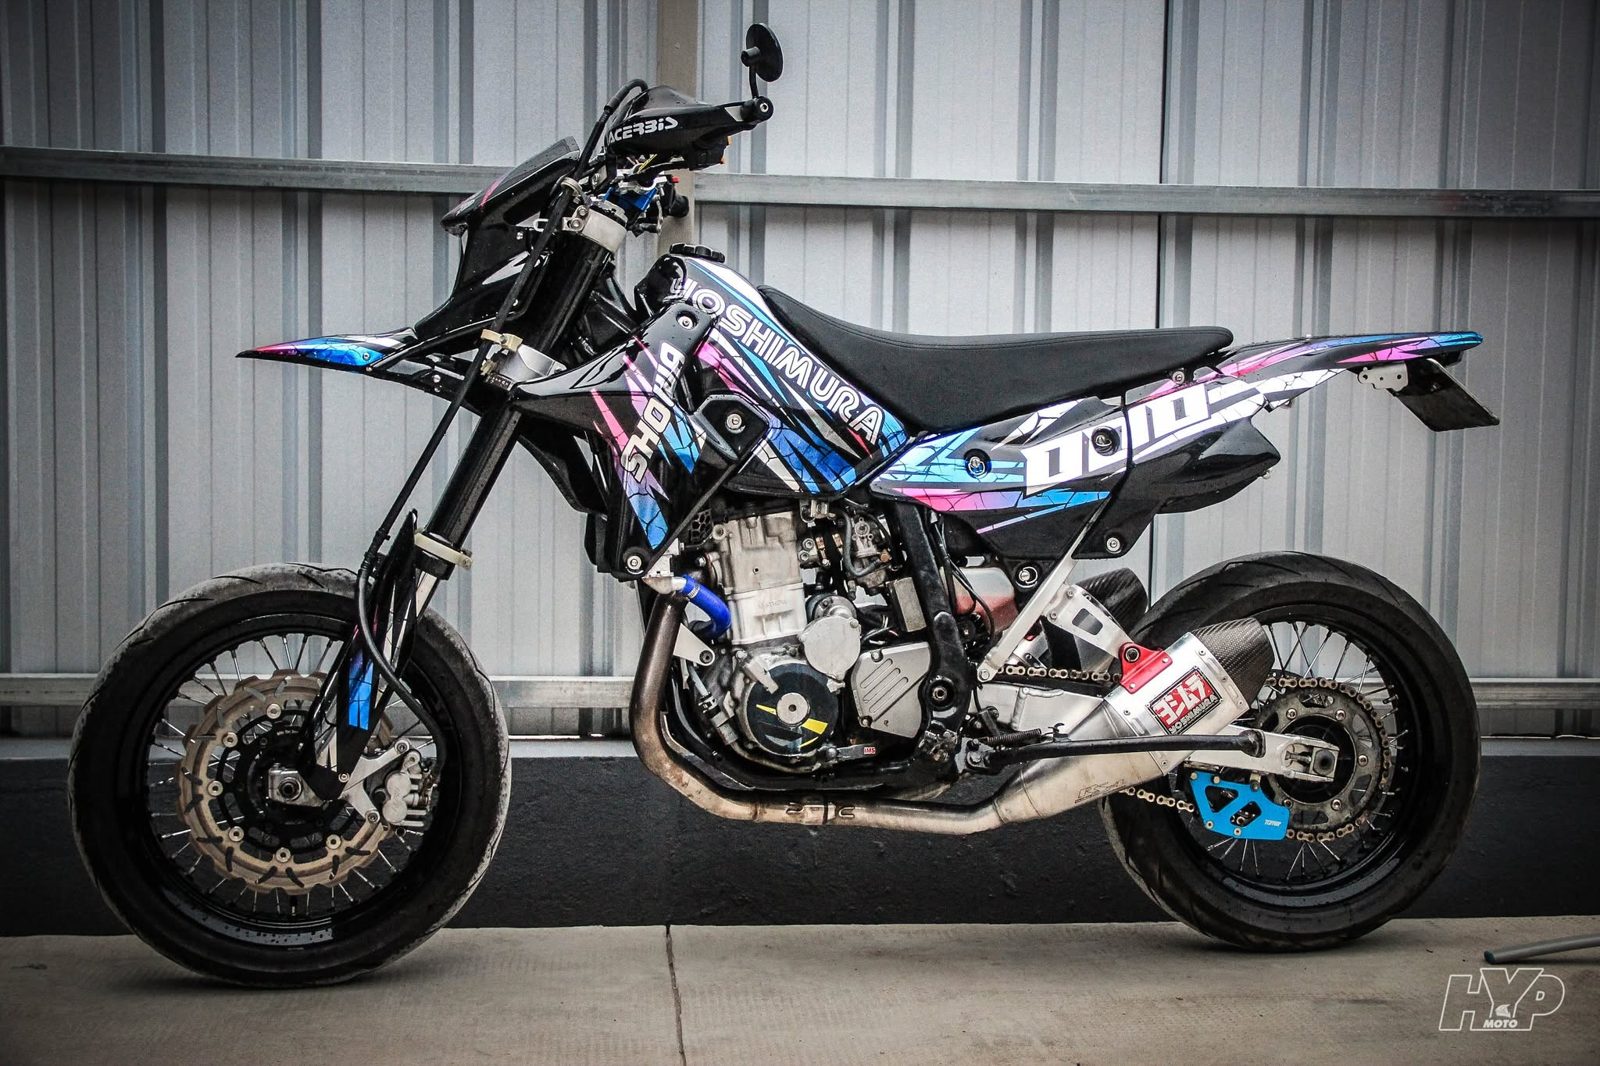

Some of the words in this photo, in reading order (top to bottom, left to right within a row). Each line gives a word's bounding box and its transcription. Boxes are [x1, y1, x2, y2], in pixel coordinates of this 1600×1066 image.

[664, 277, 885, 445] YOSHIMURA
[1152, 674, 1206, 725] ヨシムラ
[1168, 694, 1219, 735] YOSHIMURA
